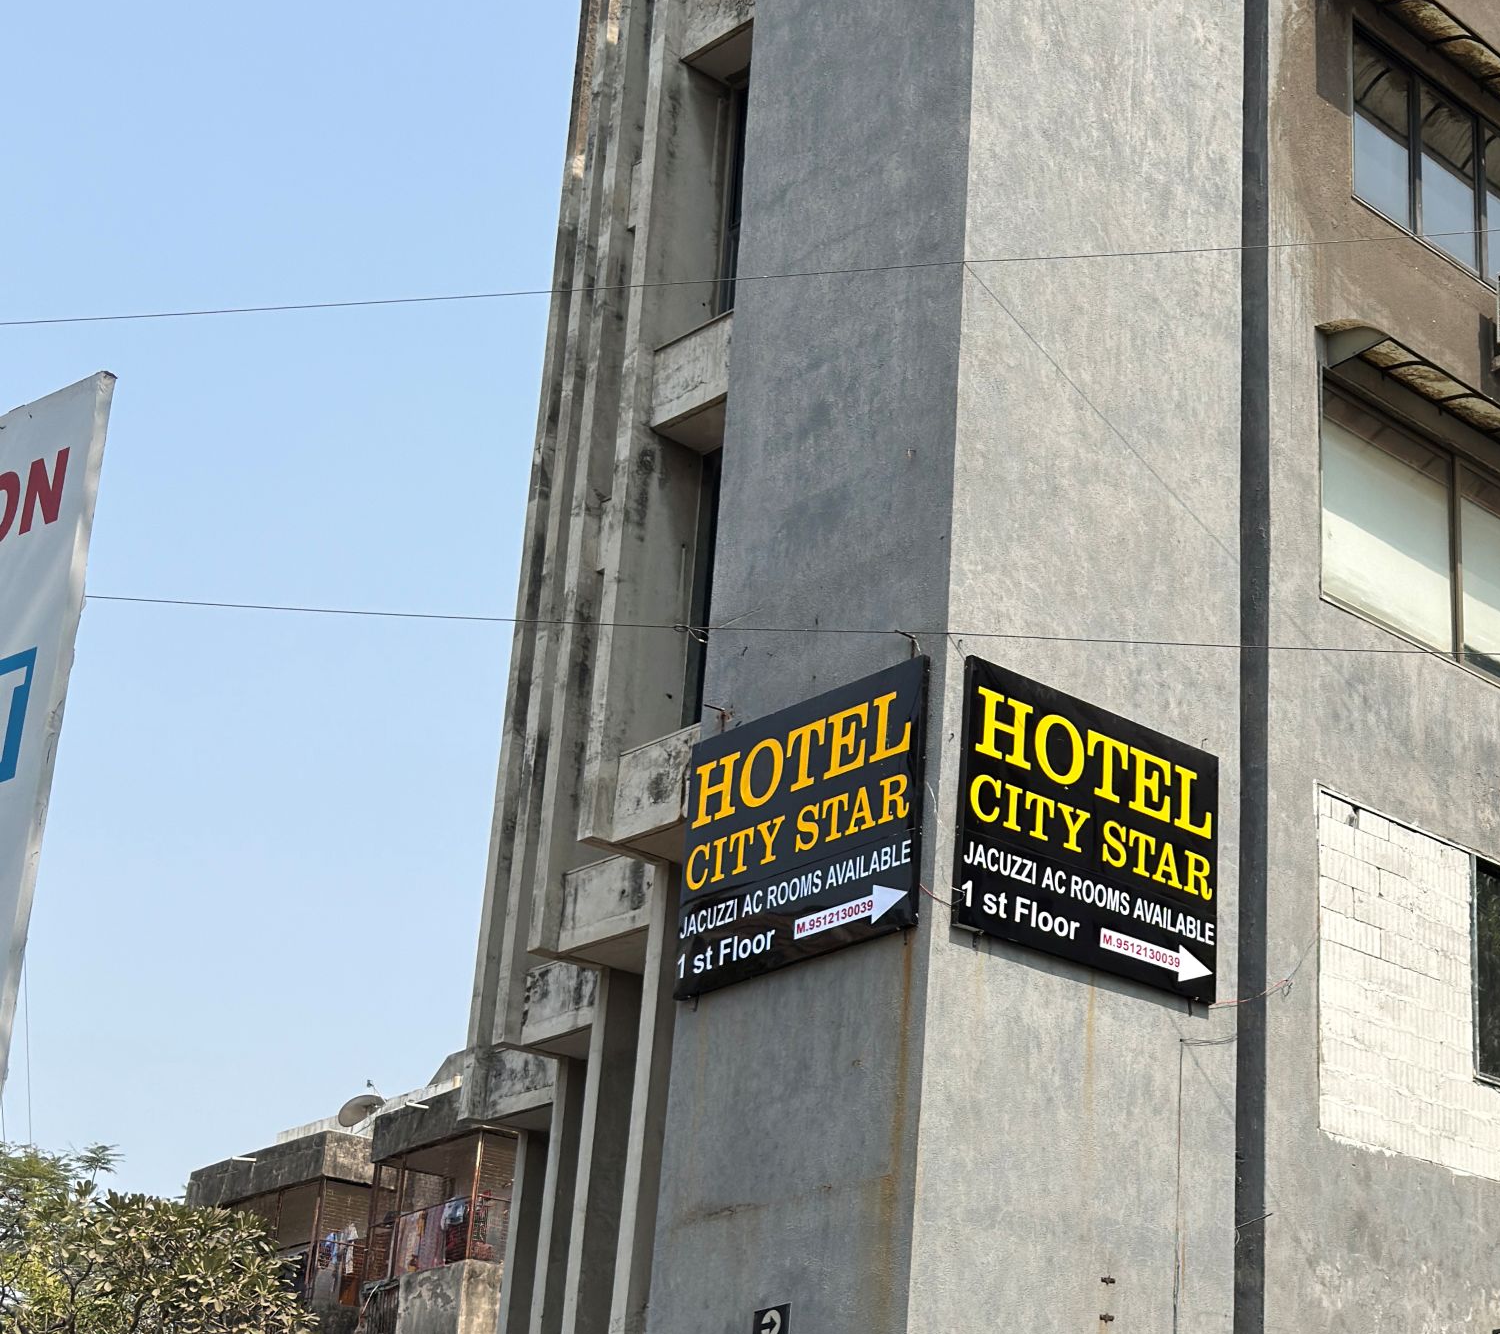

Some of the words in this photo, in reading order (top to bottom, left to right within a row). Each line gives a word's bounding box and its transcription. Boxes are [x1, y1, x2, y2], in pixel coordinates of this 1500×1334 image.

[691, 691, 911, 829] HOTEL
[975, 686, 1212, 839] HOTEL
[685, 815, 785, 891] CITY
[795, 774, 910, 852] STAR
[970, 774, 1090, 852] CITY
[1102, 820, 1213, 900] STAR
[679, 902, 737, 939] JACUZZI
[742, 891, 762, 917] AC
[767, 870, 822, 910] ROOMS
[825, 840, 912, 890] AVAILABLE
[796, 900, 873, 934] M.9512130039
[961, 880, 972, 907] 1
[983, 891, 1007, 918] st
[1015, 896, 1080, 940] Floor
[963, 841, 1036, 885] JACUZZI
[1042, 867, 1066, 894] AC
[1071, 880, 1130, 915] ROOMS
[1133, 900, 1215, 945] AVAILABLE
[677, 954, 685, 978] 1
[693, 946, 712, 974] st
[719, 930, 775, 965] Floor
[1103, 933, 1180, 968] M.9512130039
